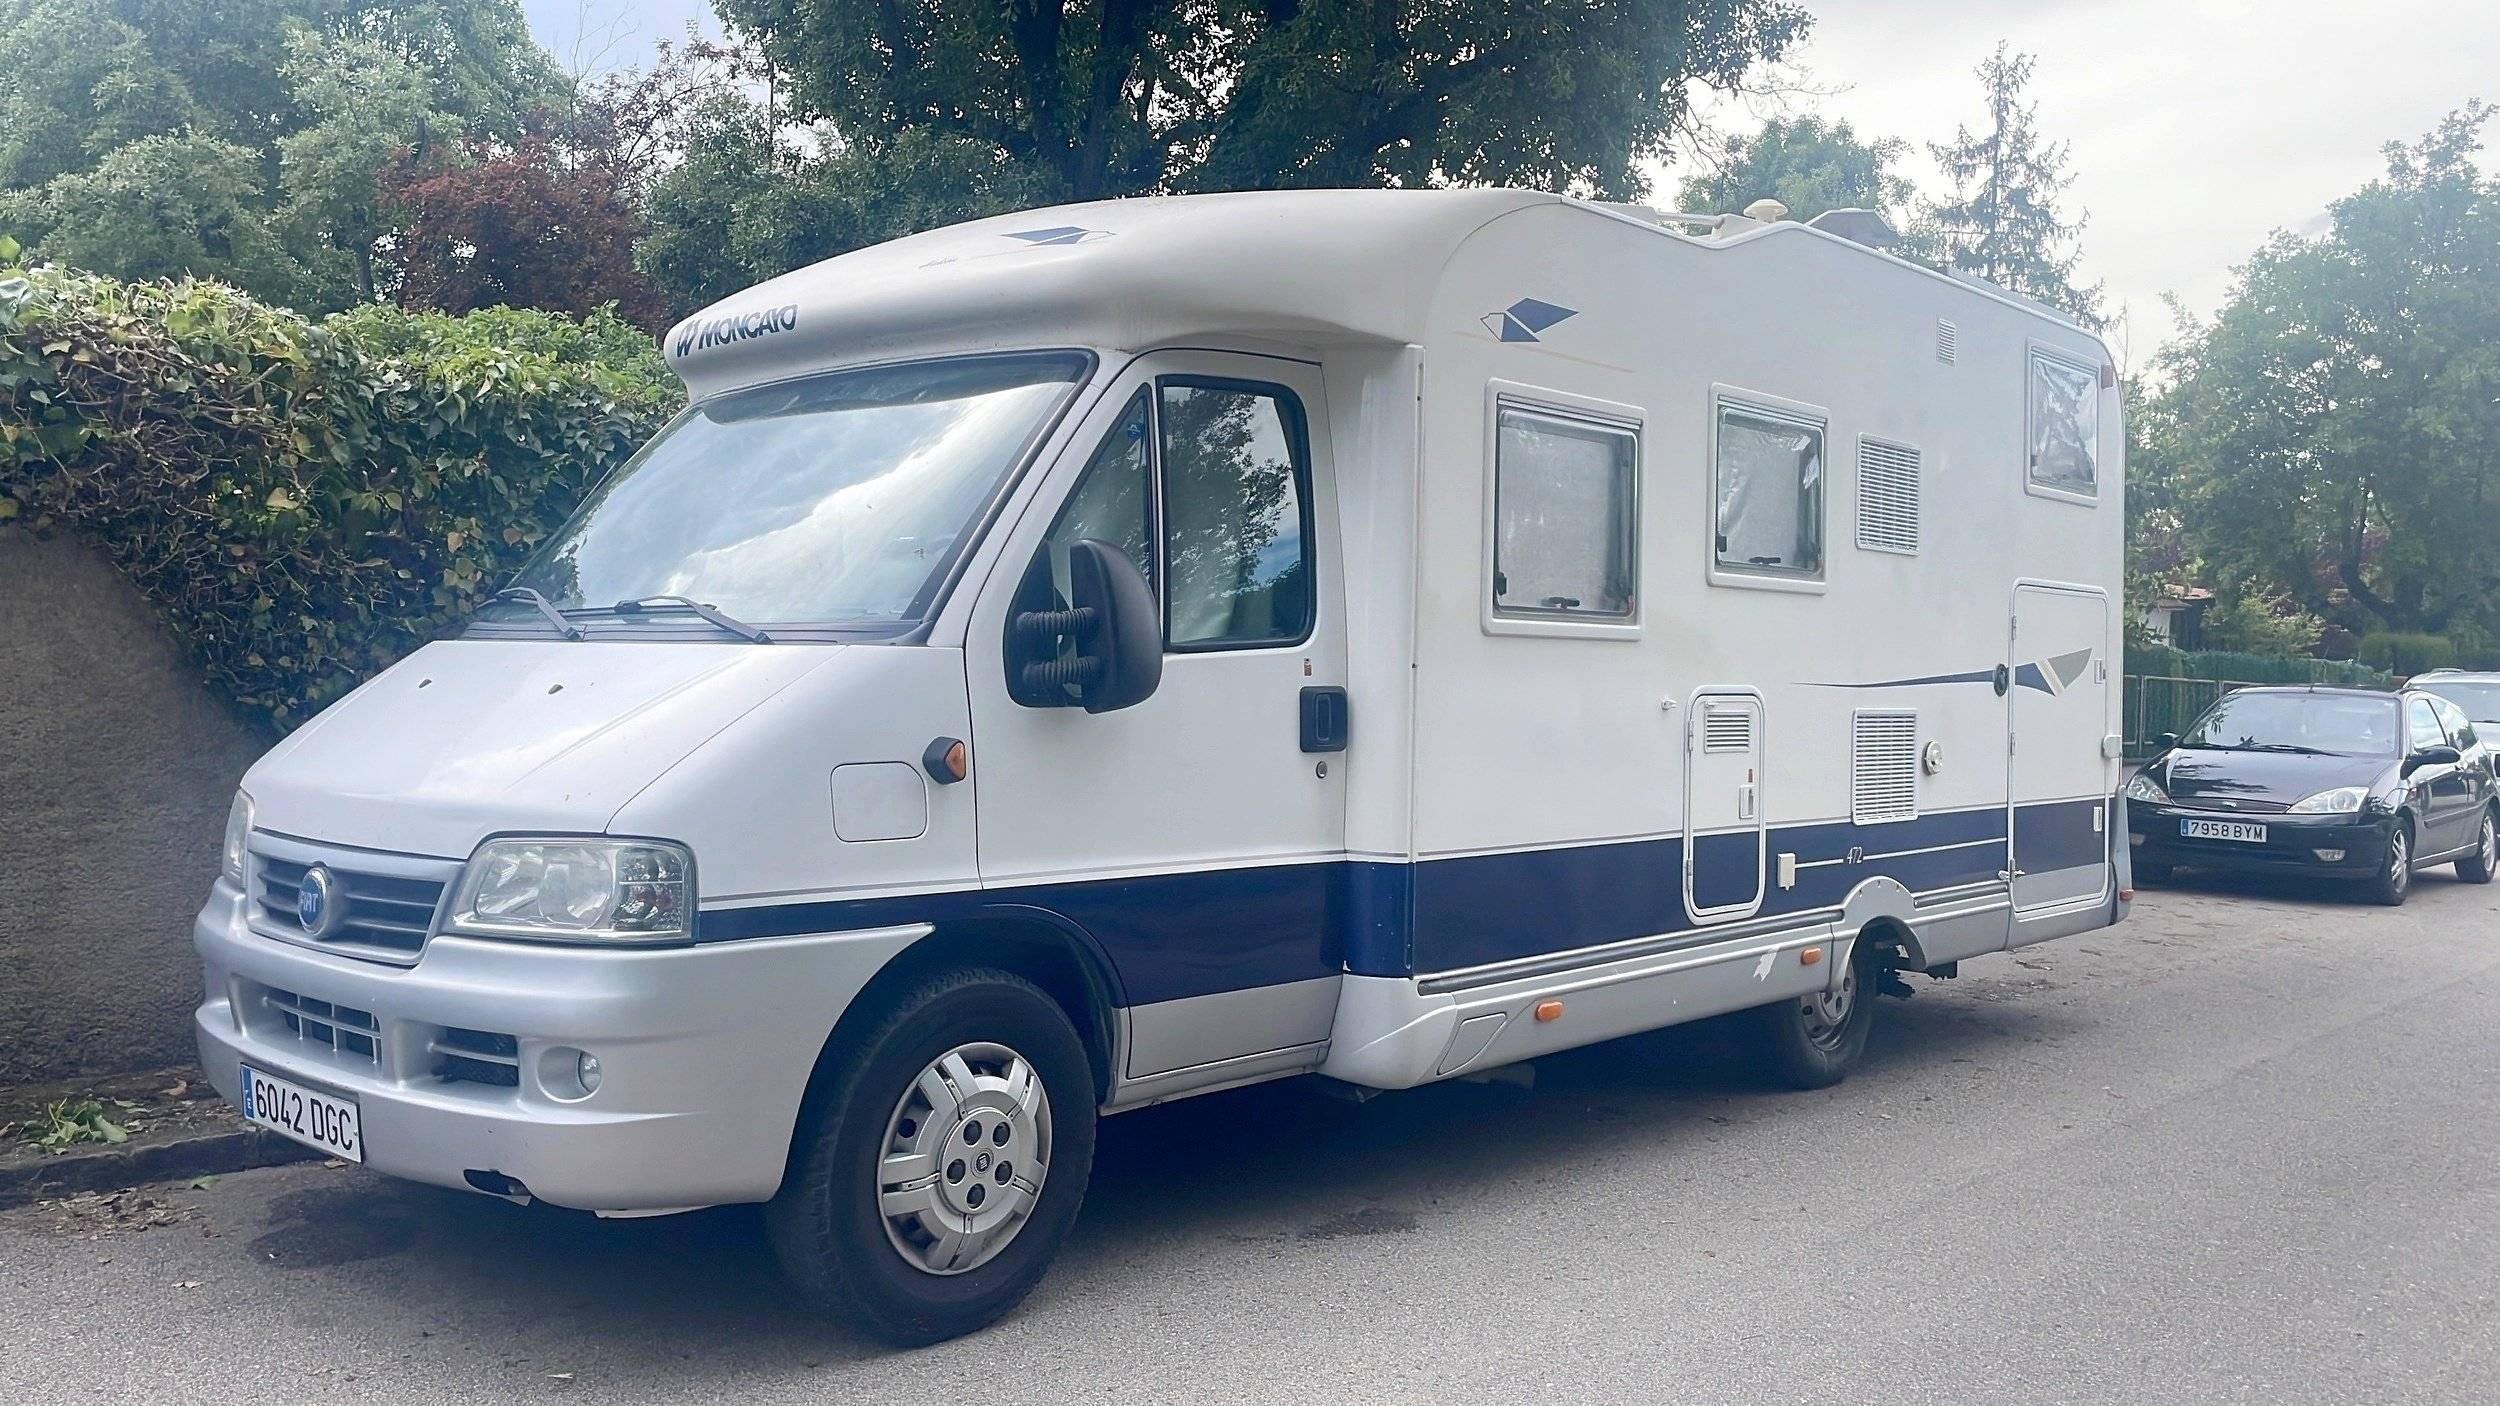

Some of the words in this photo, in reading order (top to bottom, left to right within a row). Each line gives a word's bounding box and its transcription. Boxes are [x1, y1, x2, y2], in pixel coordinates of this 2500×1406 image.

[698, 304, 798, 350] MONCAYO
[2191, 822, 2229, 836] 7958
[2233, 825, 2263, 840] BYM
[255, 1079, 305, 1135] 6042
[310, 1097, 353, 1151] DGC
